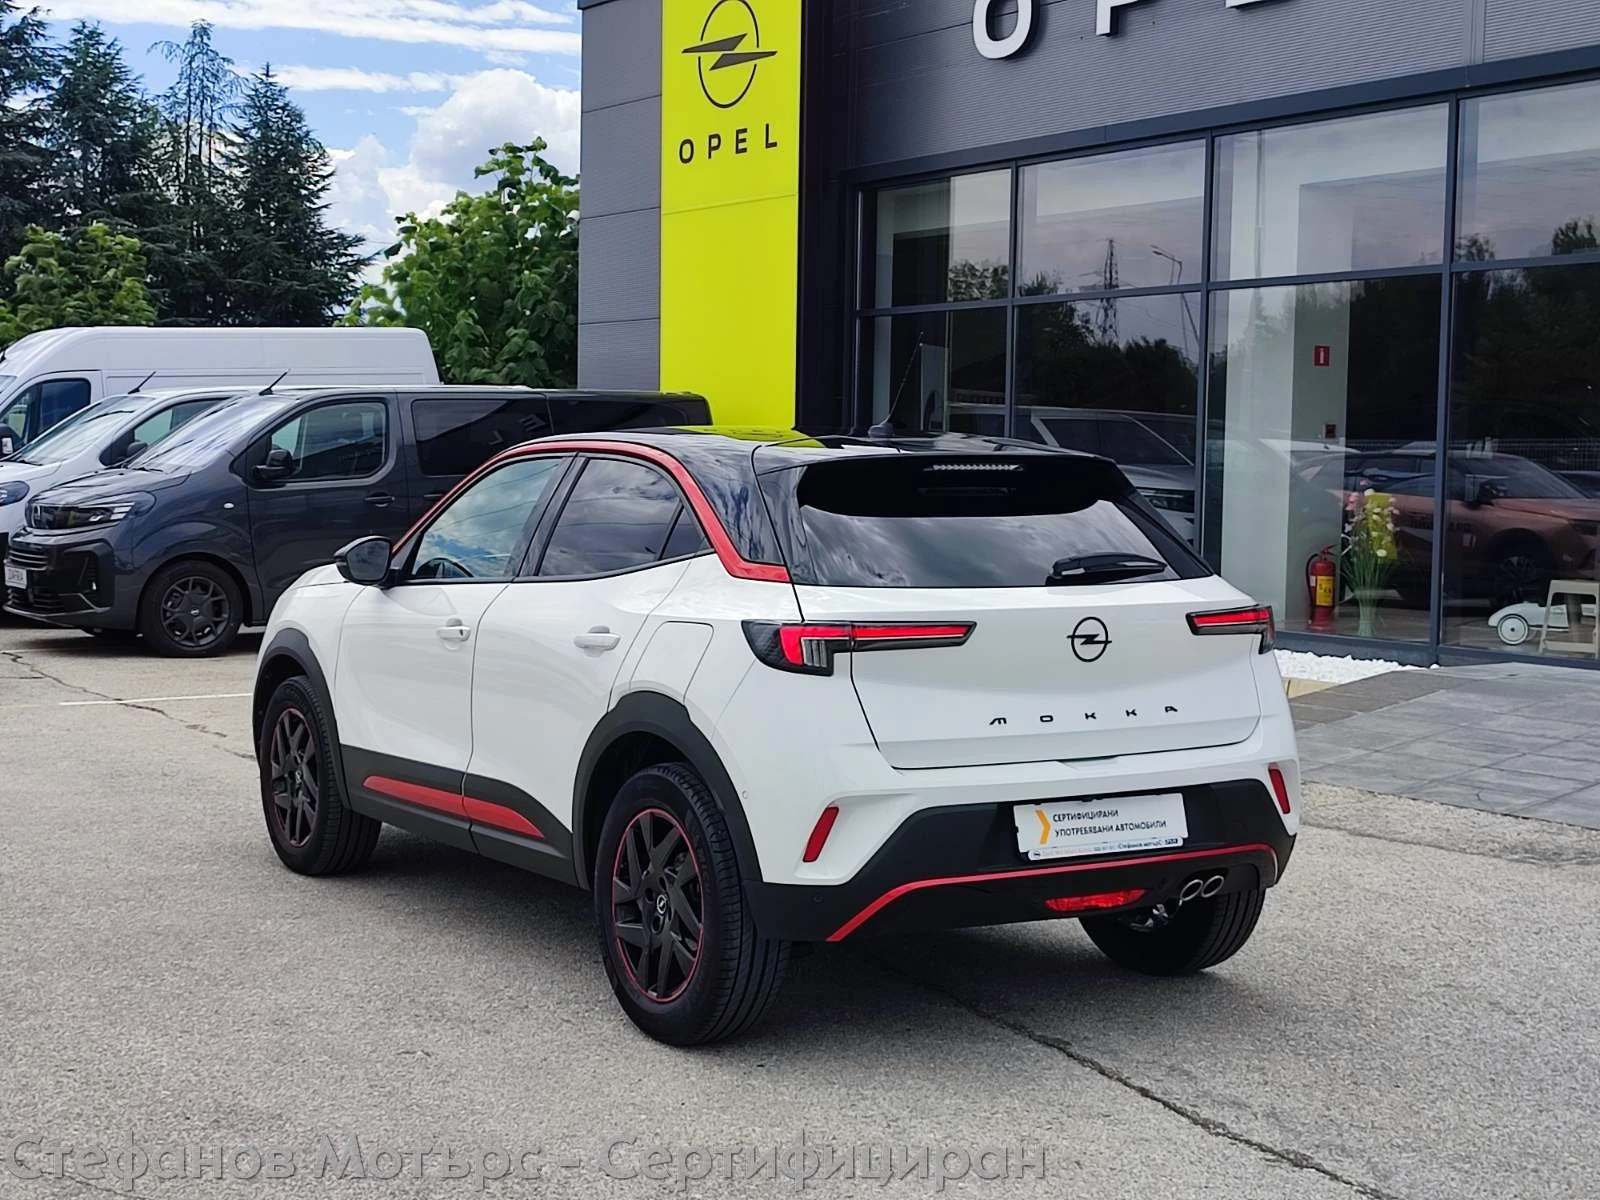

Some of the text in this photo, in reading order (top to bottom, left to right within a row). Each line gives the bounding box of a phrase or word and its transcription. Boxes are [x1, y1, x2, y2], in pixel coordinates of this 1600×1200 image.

[679, 123, 778, 164] OPEL
[989, 705, 1178, 725] MOKKA
[1052, 809, 1119, 823] СЕРТИФИЦИРАНИ
[1055, 820, 1167, 838] УПОТРЕБЯВАНИ АВТОМОБИЛИ
